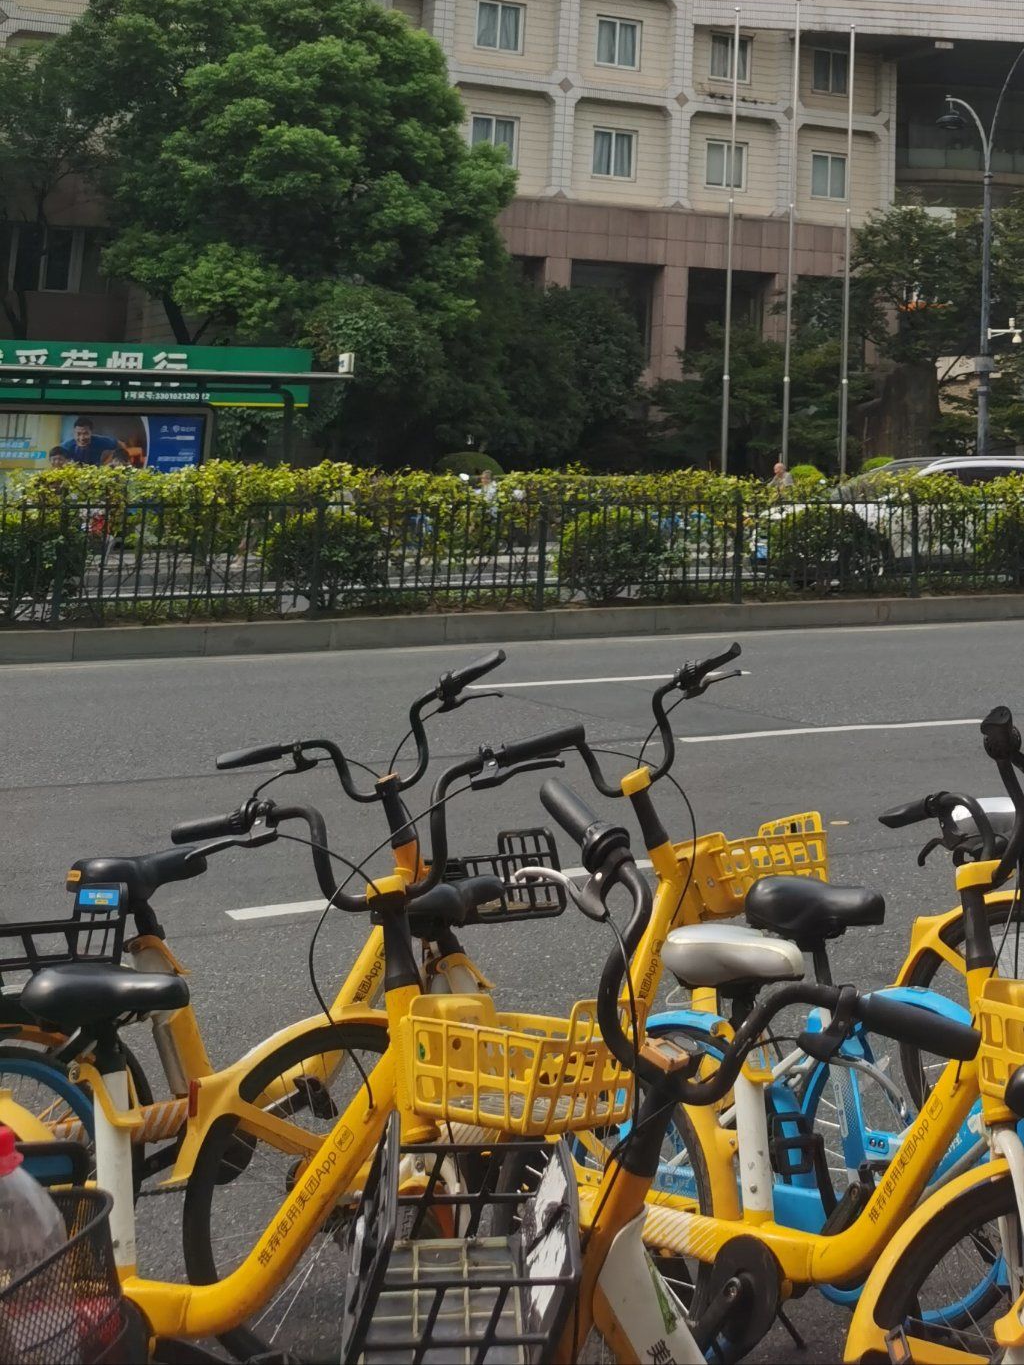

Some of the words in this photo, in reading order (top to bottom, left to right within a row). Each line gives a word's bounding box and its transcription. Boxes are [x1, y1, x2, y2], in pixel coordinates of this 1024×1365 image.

[257, 1151, 337, 1268] 推荐使用美团App
[868, 1119, 930, 1224] 推荐使用美团App
